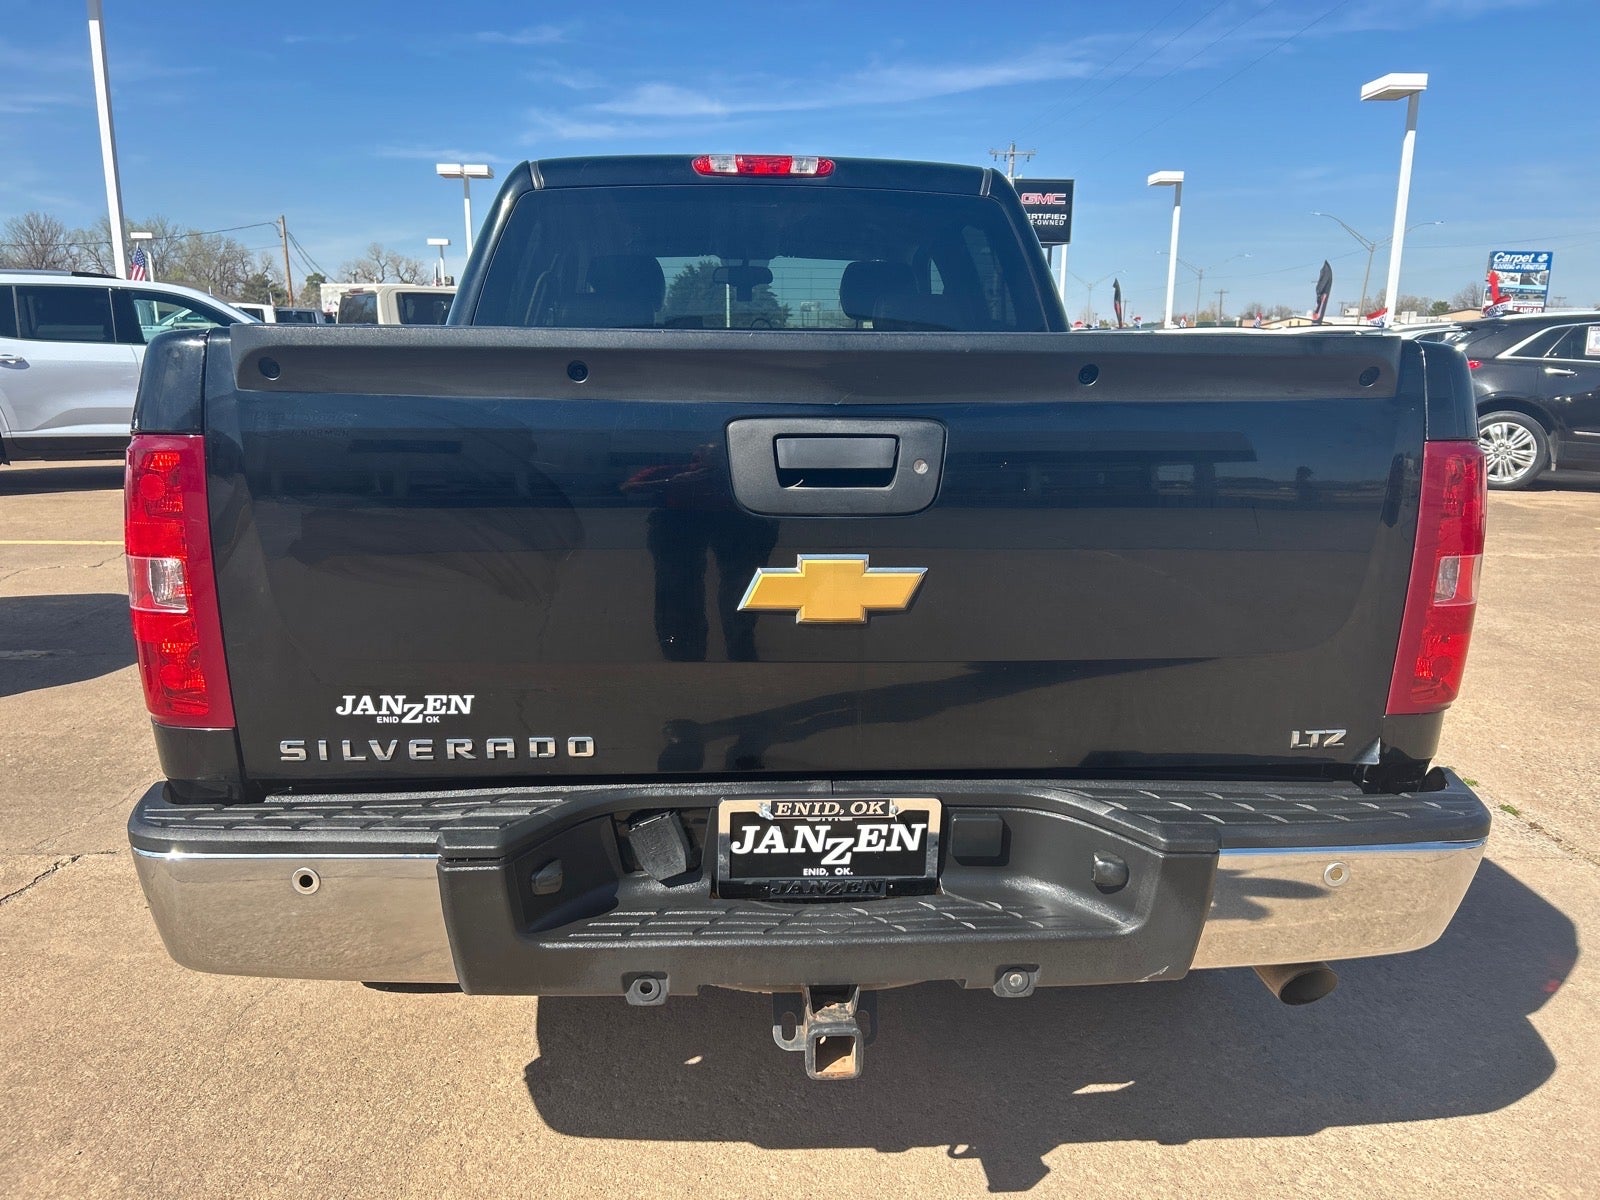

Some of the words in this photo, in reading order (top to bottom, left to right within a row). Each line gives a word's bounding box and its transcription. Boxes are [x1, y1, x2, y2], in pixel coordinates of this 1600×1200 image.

[1021, 193, 1066, 205] GMC
[1494, 252, 1535, 266] Carpet
[336, 694, 475, 723] JANZEN
[376, 716, 399, 724] ENID
[425, 716, 440, 724] OK
[1290, 729, 1347, 749] LTZ
[279, 736, 595, 761] SILVERADO
[775, 801, 845, 816] ENID,
[850, 801, 886, 815] OK
[730, 823, 927, 865] JANZEN
[803, 867, 829, 876] ENID,
[834, 867, 853, 876] OK.
[770, 879, 884, 896] JANZEN
